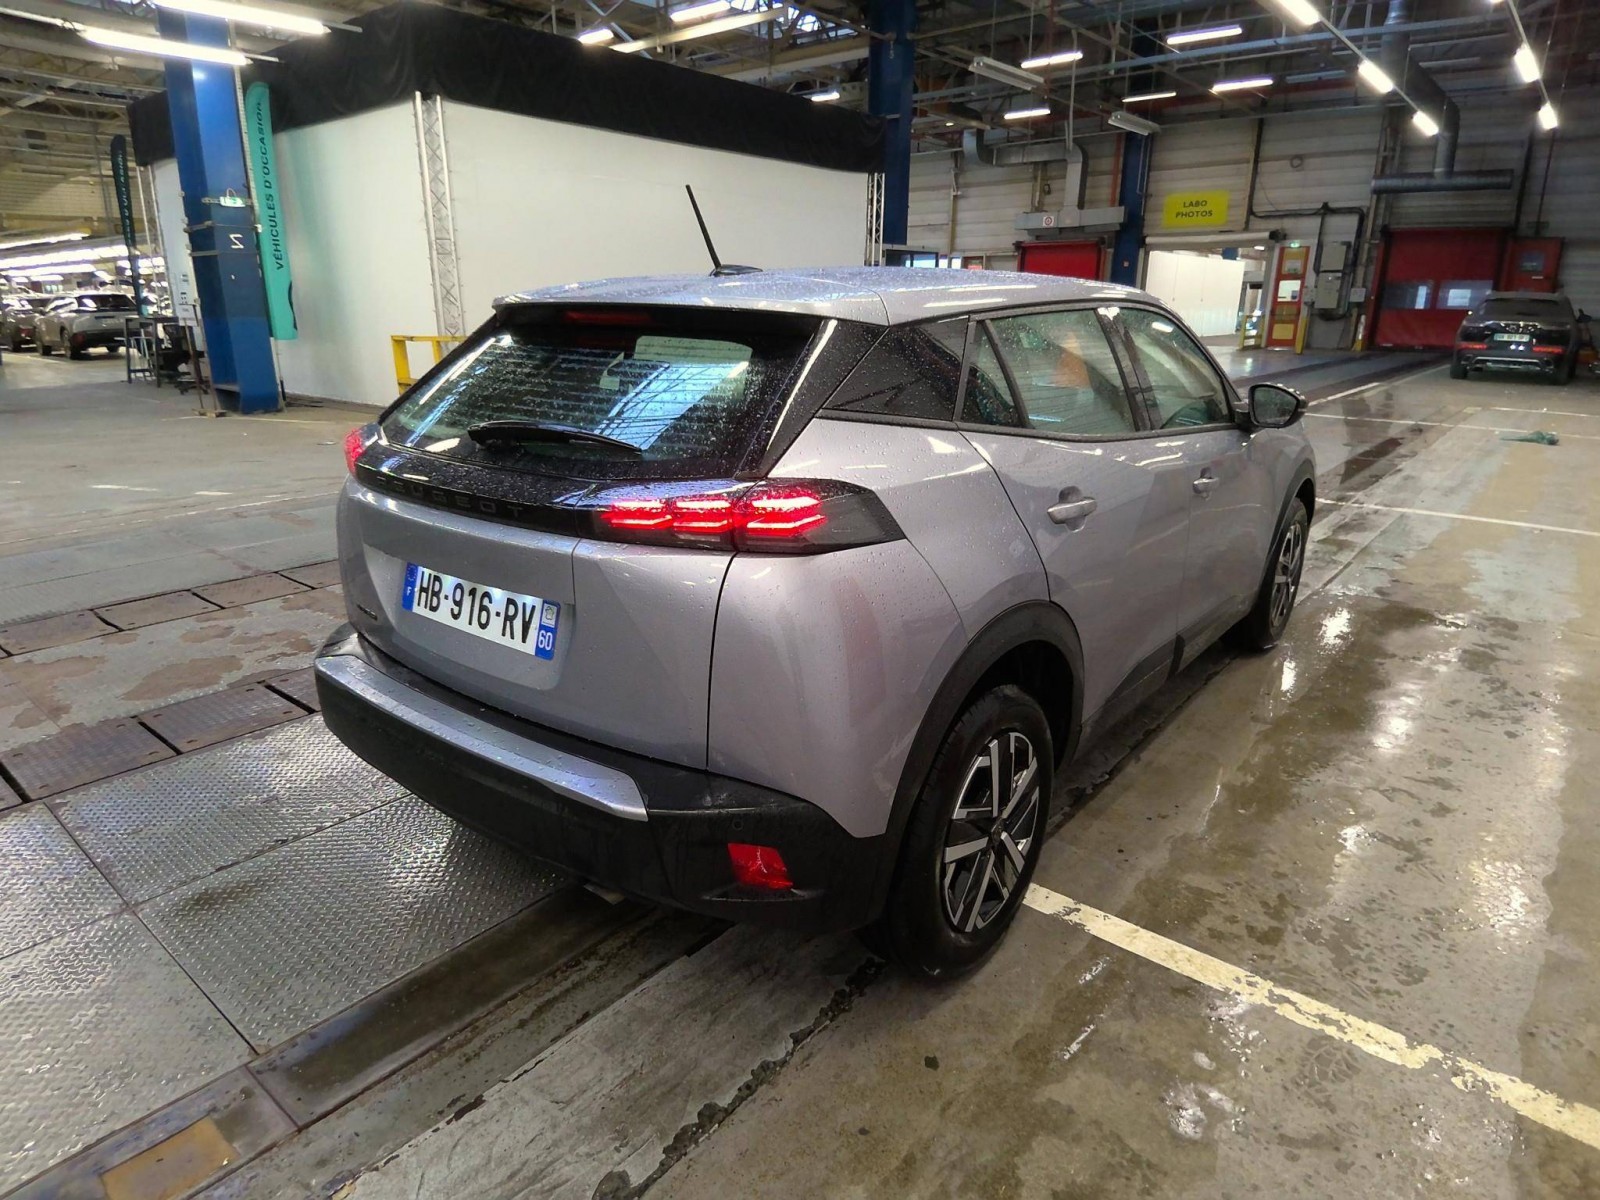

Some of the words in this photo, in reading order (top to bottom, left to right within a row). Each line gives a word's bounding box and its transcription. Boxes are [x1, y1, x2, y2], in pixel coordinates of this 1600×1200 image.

[1183, 200, 1208, 208] LABO
[1175, 210, 1213, 218] PHOTOS
[264, 191, 284, 270] VÉHICULES
[406, 586, 412, 596] F
[417, 570, 536, 644] HB-916-RV
[537, 629, 553, 651] 60
